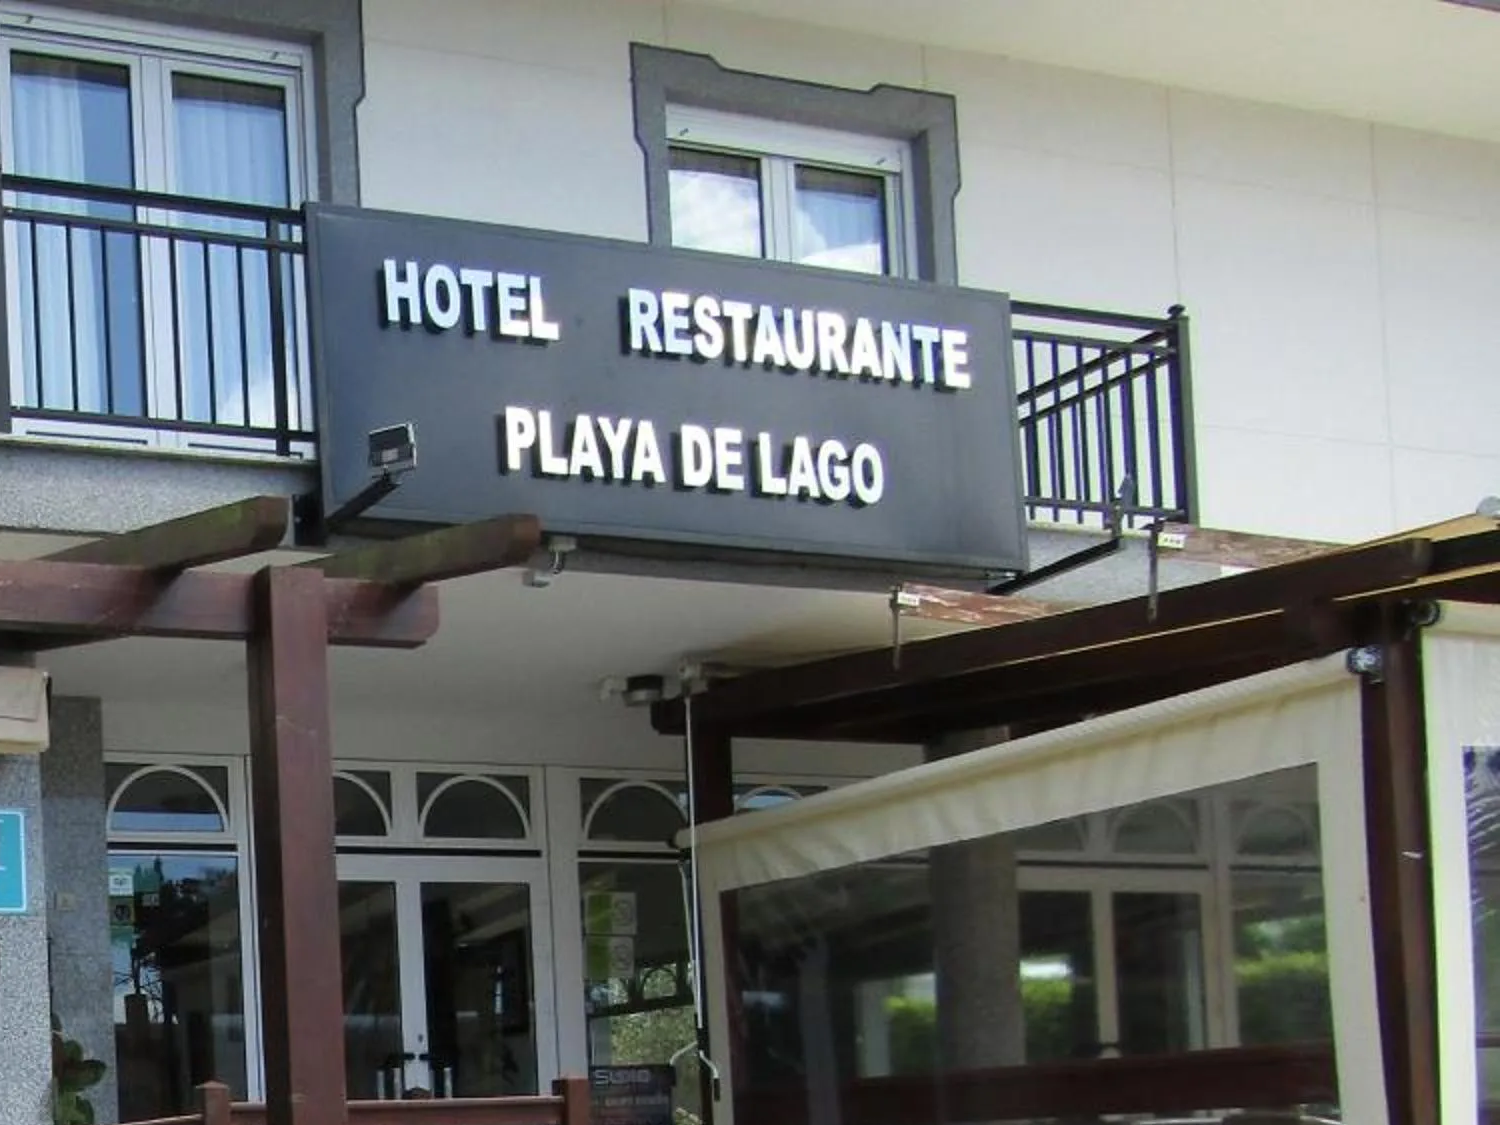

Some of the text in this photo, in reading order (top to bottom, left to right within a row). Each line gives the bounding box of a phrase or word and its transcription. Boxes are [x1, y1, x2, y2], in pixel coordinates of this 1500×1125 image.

[383, 258, 973, 390] HOTEL RESTAURANTE
[505, 405, 886, 505] PLAYA DE LAGO
